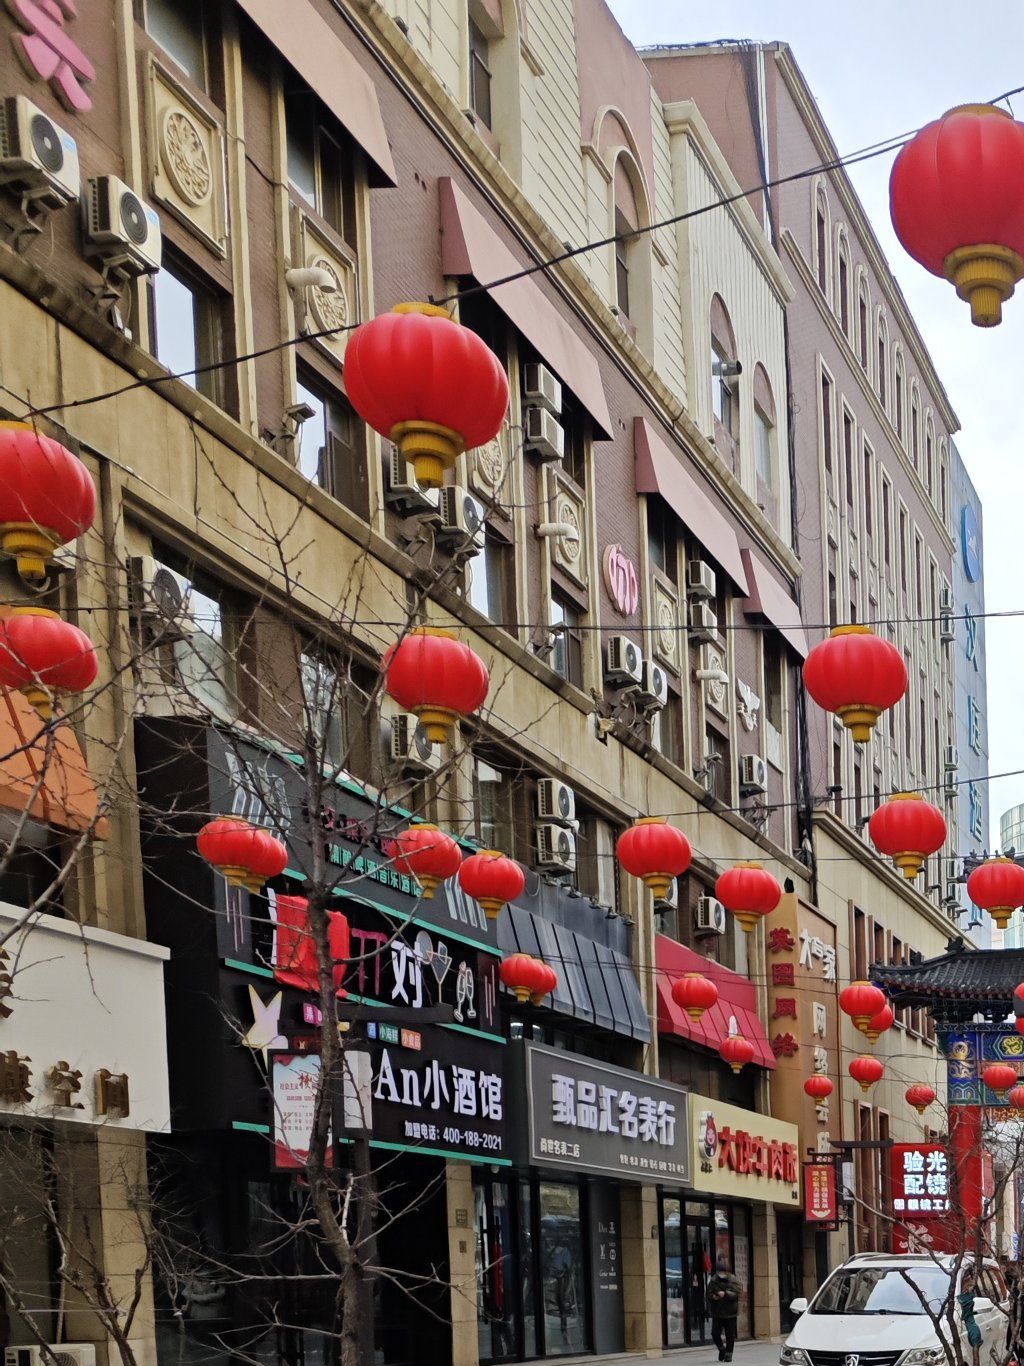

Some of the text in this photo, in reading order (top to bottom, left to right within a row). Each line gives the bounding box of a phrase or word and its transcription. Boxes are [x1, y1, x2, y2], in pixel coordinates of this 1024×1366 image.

[551, 1073, 676, 1146] 甄品汇名表行
[903, 1151, 947, 1172] 验光
[903, 1173, 947, 1196] 配镜
